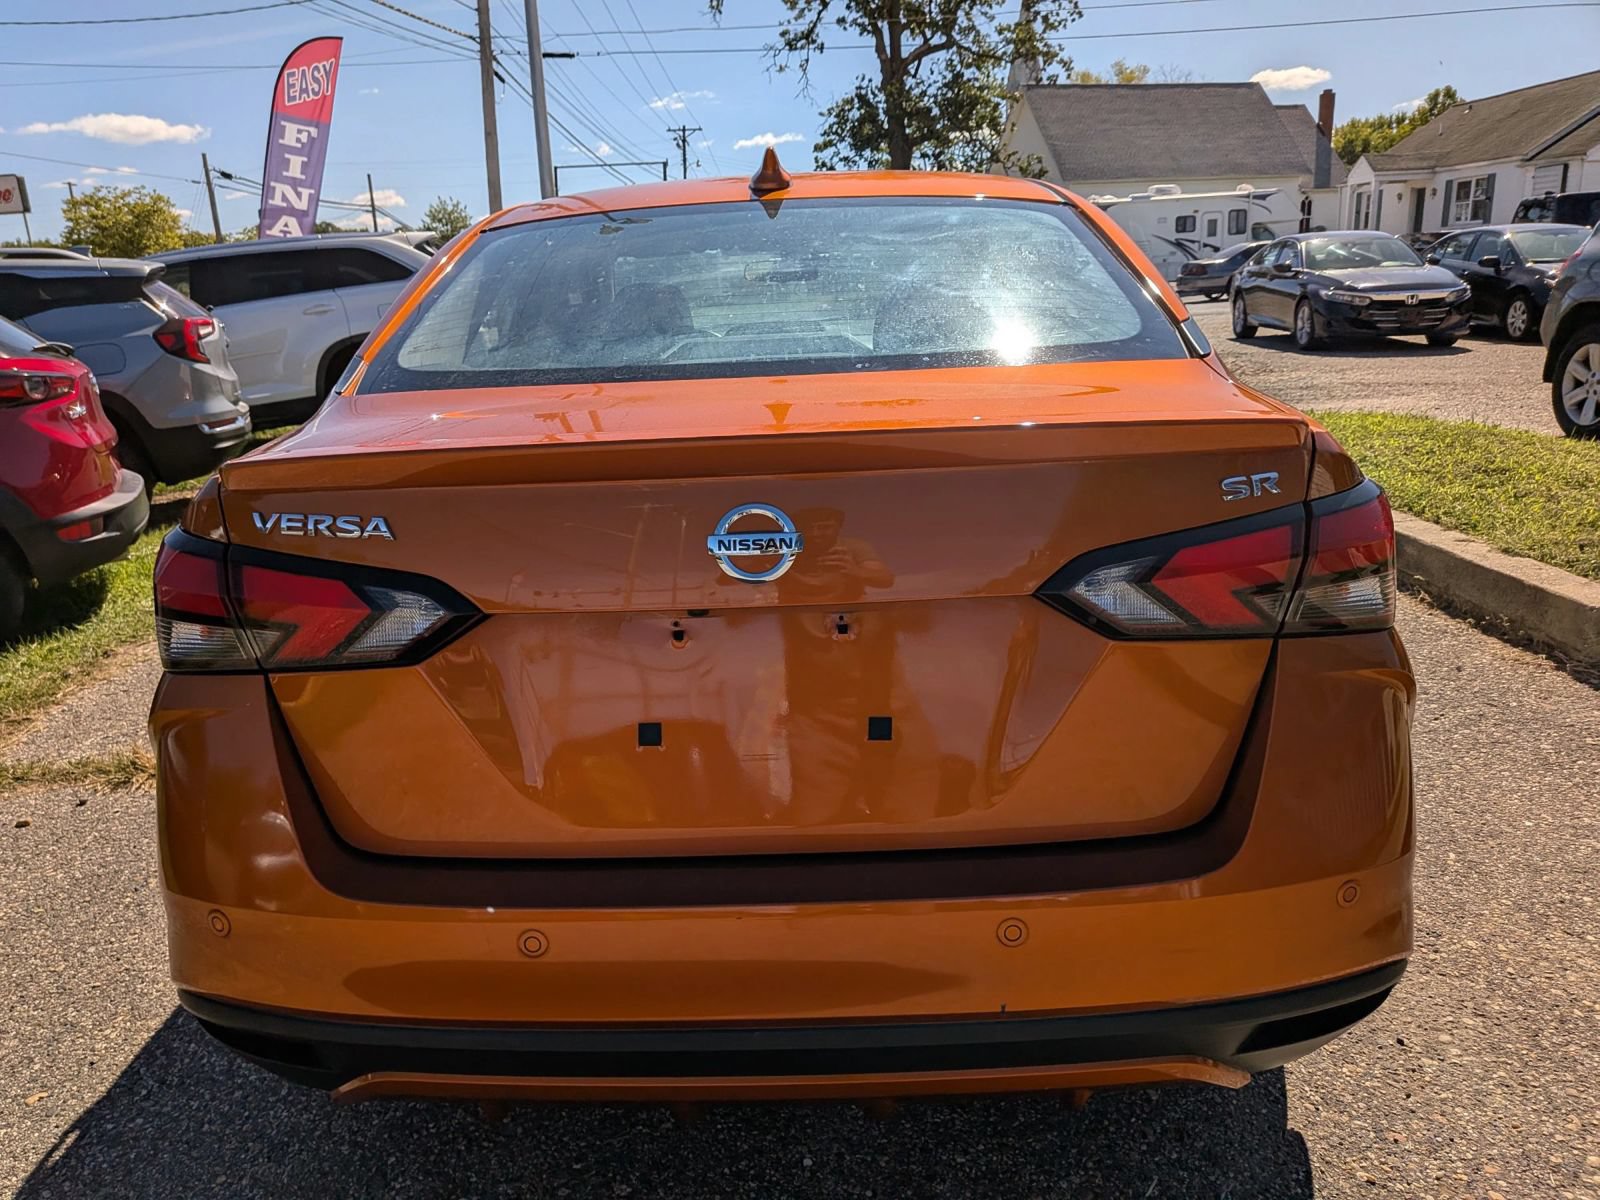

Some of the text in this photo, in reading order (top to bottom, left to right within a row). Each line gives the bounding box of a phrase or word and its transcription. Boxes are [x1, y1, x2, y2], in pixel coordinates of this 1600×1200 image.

[285, 59, 335, 105] EASY
[1221, 471, 1281, 501] SR
[252, 512, 394, 541] VERSA
[717, 538, 793, 551] NISSAN
